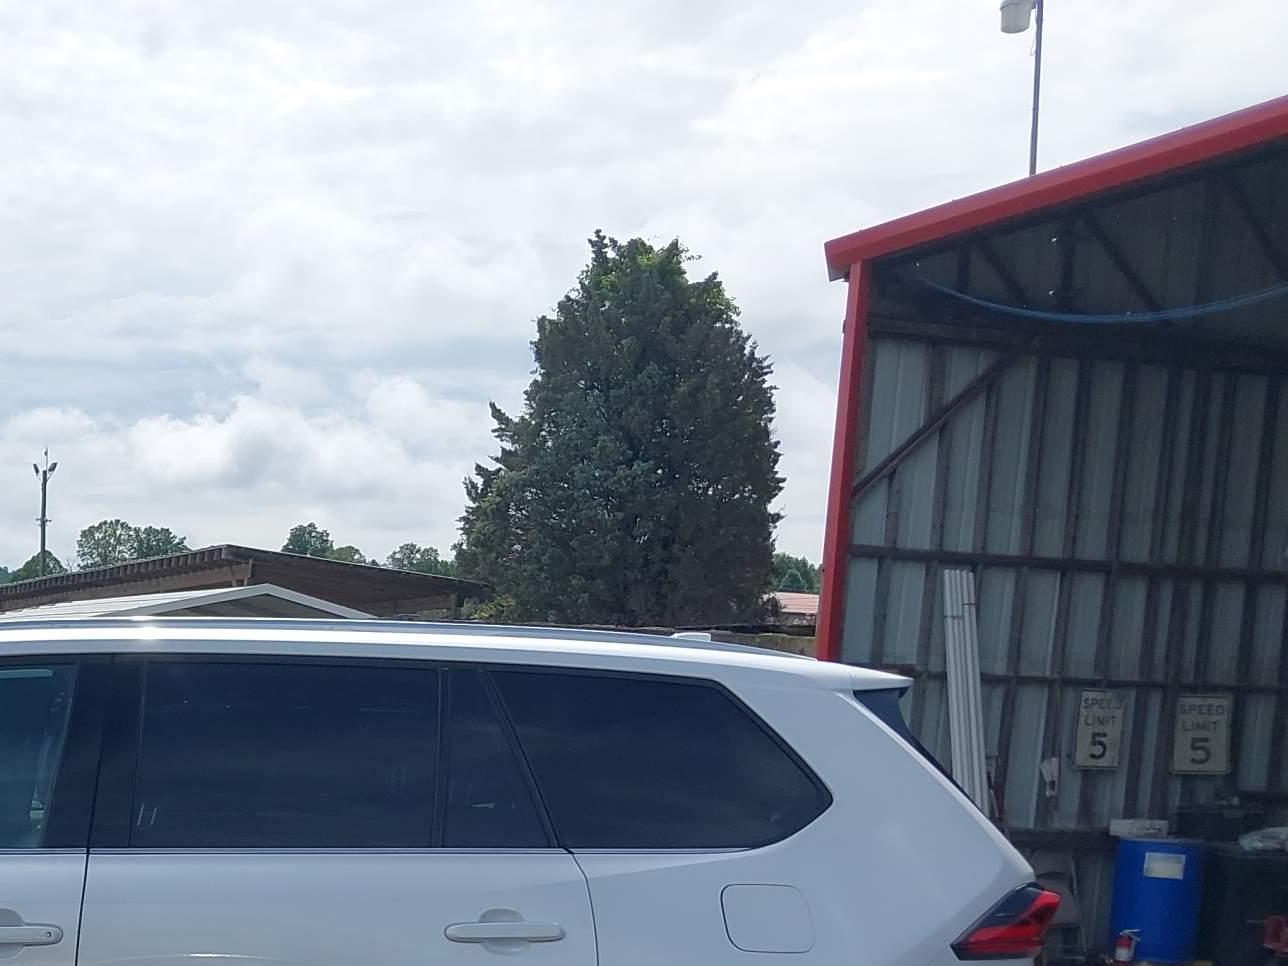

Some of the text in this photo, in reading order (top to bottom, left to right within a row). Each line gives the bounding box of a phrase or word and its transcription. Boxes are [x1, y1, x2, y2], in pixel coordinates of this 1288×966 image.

[1179, 703, 1225, 716] SPEED
[1084, 714, 1117, 727] LIMIT
[1182, 720, 1219, 732] LIMIT
[1089, 732, 1107, 760] 5
[1190, 736, 1210, 765] 5
